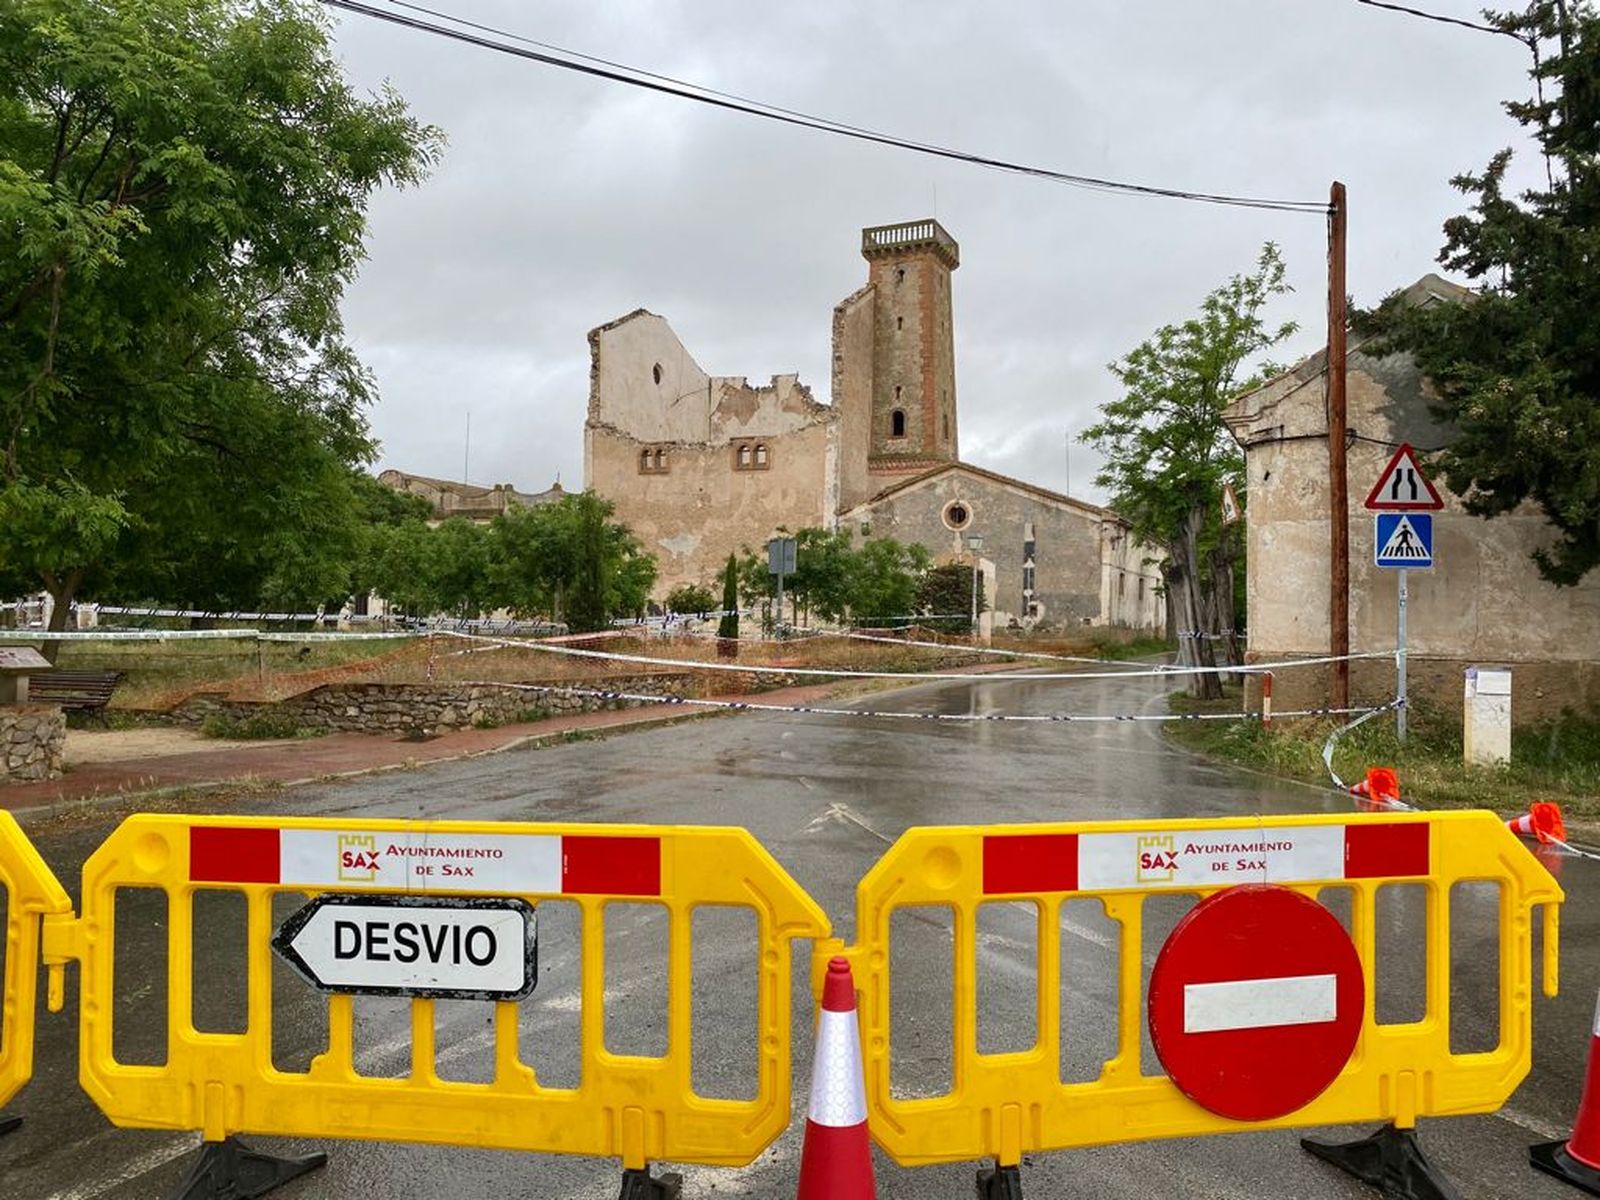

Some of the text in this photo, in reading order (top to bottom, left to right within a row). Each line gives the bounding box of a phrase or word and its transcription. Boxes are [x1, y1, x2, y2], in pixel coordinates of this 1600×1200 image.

[342, 851, 381, 870] SAX
[1140, 851, 1179, 870] SAX
[334, 920, 497, 966] DESVIO
